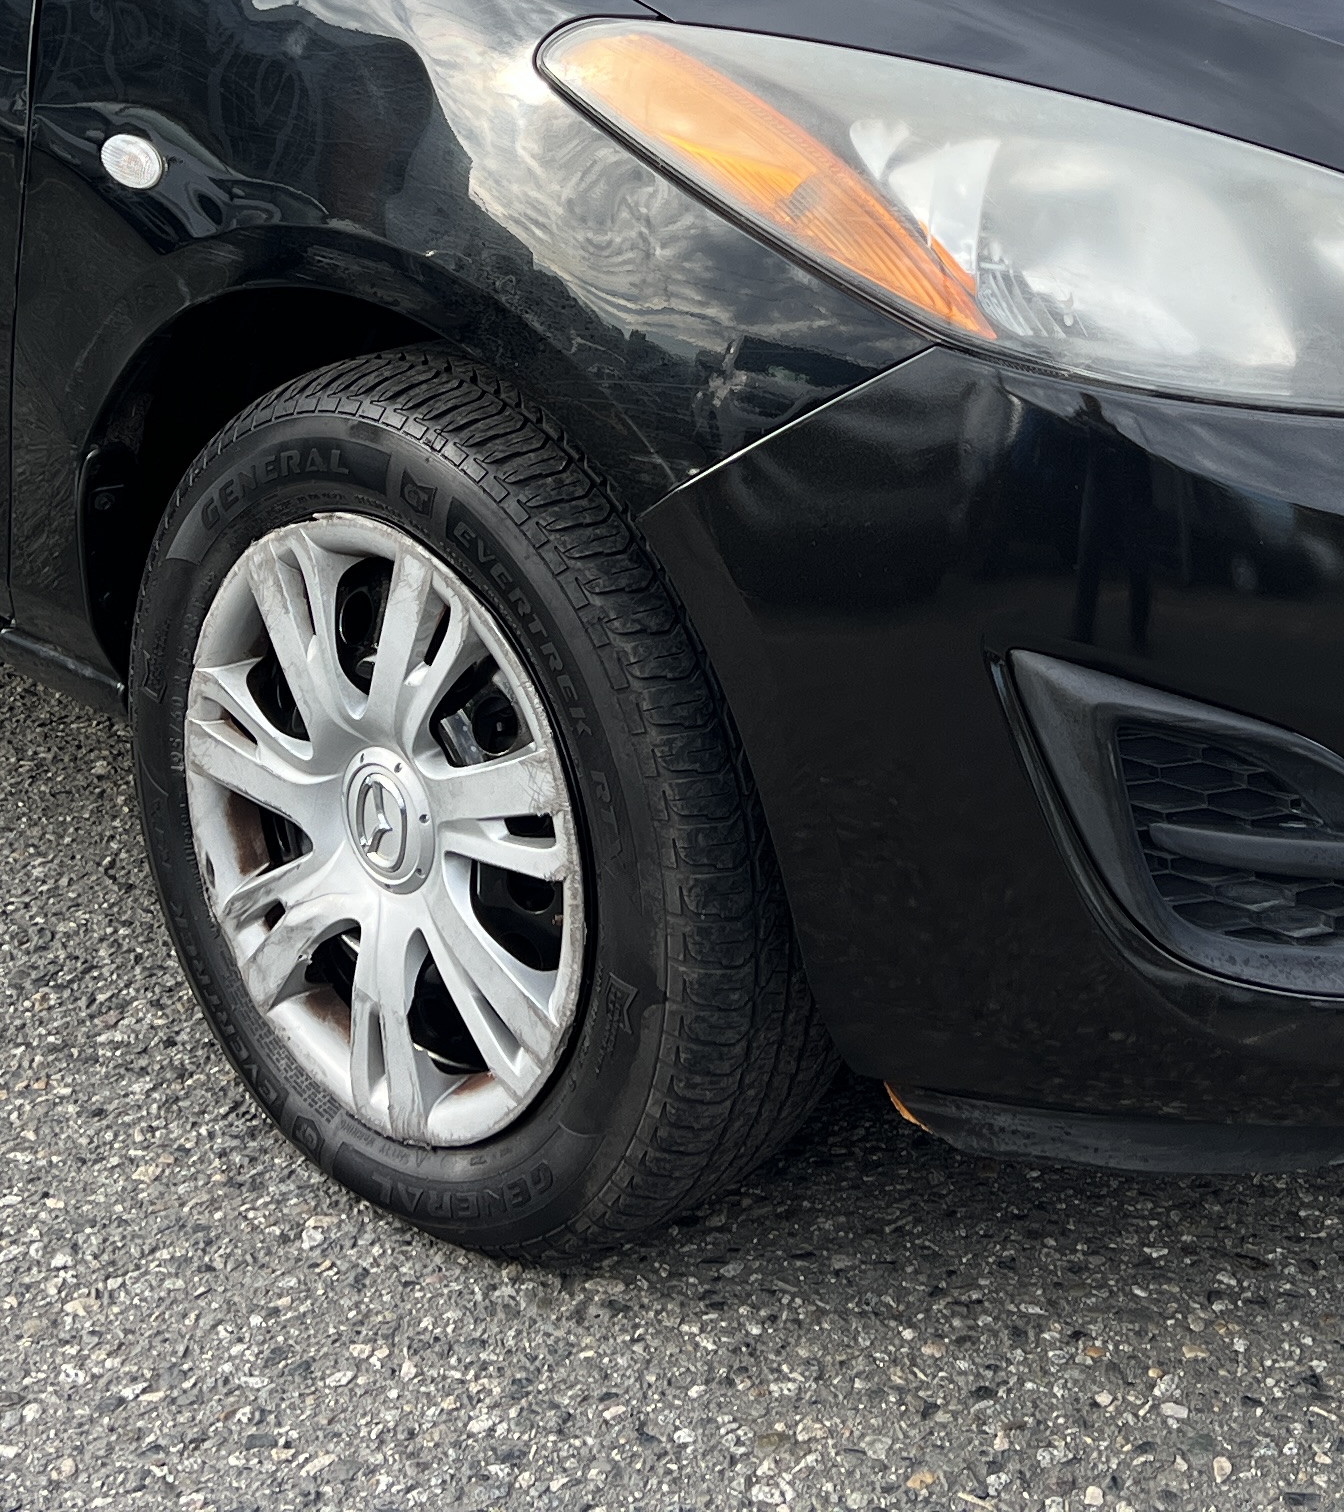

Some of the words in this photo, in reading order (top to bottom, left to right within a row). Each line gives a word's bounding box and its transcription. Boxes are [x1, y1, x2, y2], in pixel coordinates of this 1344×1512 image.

[196, 447, 350, 534] GENERAL
[451, 514, 593, 742] EVERTREK
[369, 1154, 558, 1221] GENERAL
